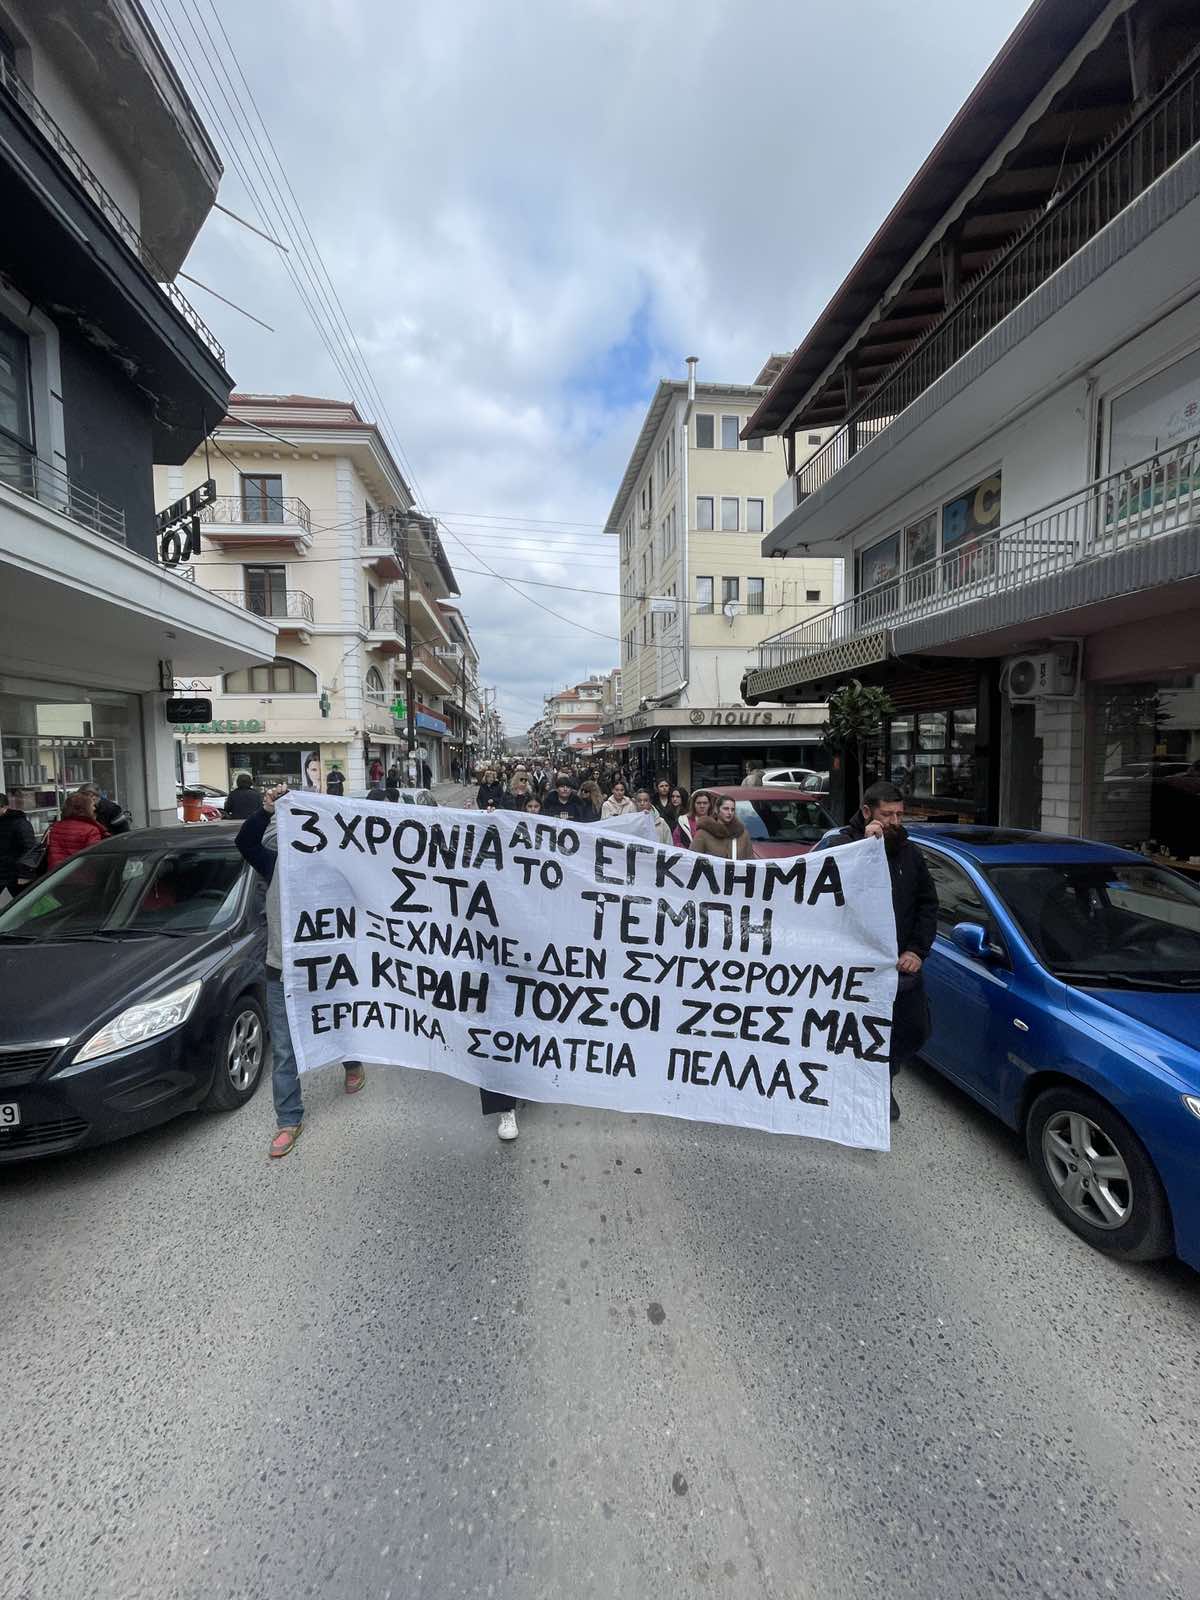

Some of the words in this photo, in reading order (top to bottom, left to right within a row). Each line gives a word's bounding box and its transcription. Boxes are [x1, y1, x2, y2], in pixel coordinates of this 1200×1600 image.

[710, 710, 772, 725] hours
[290, 808, 328, 853] 3
[334, 813, 503, 871] ΧΡΟΝΙΑ
[509, 821, 580, 857] ΑΠΟ
[513, 857, 563, 890] ΤΟ
[595, 837, 846, 907] ΕΓΚΛΗΜΑ
[391, 867, 499, 927] ΣΤΑ
[581, 891, 772, 956] ΤΕΜΠΗ
[294, 906, 356, 942] ΔΕΝ
[537, 943, 607, 980] ΔΕΝ
[623, 950, 876, 1003] ΣΥΓΧΩΡΟΥΜΕ
[294, 953, 358, 992] ΤΑ
[371, 952, 489, 1013] ΚΕΡΔΗ
[676, 999, 793, 1045] ΖΩΕΣ
[801, 1007, 892, 1063] ΜΑΣ
[312, 1000, 446, 1044] ΕΡΓΑΤΙΚΑ
[467, 1028, 636, 1077] ΣΩΜΑΤΕΙΑ
[667, 1047, 829, 1107] ΠΕΛΛΑΣ
